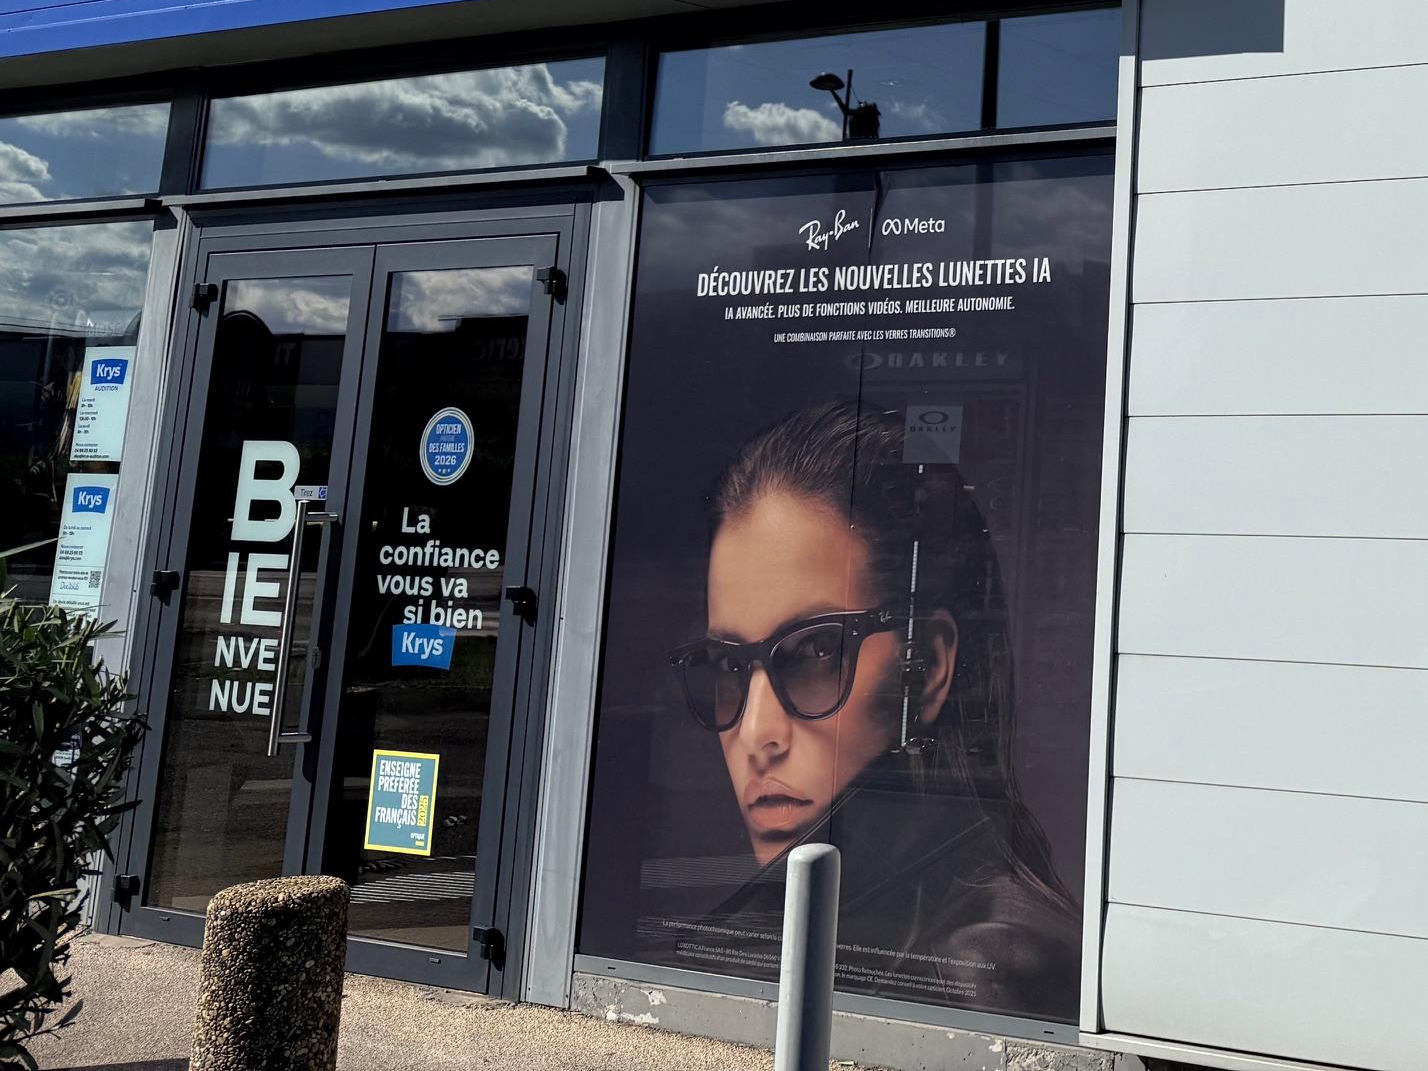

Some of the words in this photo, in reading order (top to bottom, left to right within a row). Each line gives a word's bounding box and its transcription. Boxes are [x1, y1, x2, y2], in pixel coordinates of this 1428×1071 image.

[799, 209, 860, 251] Ray-Ban
[904, 217, 945, 234] Meta
[697, 266, 795, 297] DÉCOUVREZ
[799, 267, 829, 293] LES
[834, 262, 933, 291] NOUVELLES
[938, 258, 1027, 287] LUNETTES
[1032, 257, 1051, 283] IA
[725, 306, 734, 320] IA
[735, 302, 775, 320] AVANCÉE.
[778, 304, 800, 318] PLUS
[802, 303, 814, 317] DE
[816, 302, 866, 317] FONCTIONS
[868, 298, 903, 315] VIDÉOS.
[905, 298, 955, 313] MEILLEURE
[957, 296, 1015, 312] AUTONOMIE.
[774, 333, 786, 343] UNE
[787, 332, 828, 342] COMBINAISON
[829, 330, 856, 341] PARFAITE
[857, 330, 872, 340] AVEC
[873, 330, 884, 340] LES
[885, 329, 908, 340] VERRES
[96, 363, 121, 380] Krys
[435, 423, 462, 435] OPTICIEN
[428, 442, 439, 452] DES
[440, 442, 465, 453] FAMILLES
[434, 455, 457, 465] 2026
[77, 490, 103, 508] Krys
[401, 506, 431, 534] La
[379, 540, 500, 570] confiance
[376, 574, 433, 597] vous
[440, 576, 469, 598] va
[403, 599, 425, 626] si
[429, 601, 483, 630] bien
[401, 631, 443, 660] Krys
[380, 760, 421, 778] ENSEIGNE
[378, 775, 420, 794] PRÉFÉRÉE
[401, 793, 418, 810] DES
[375, 806, 417, 829] FRANÇAIS
